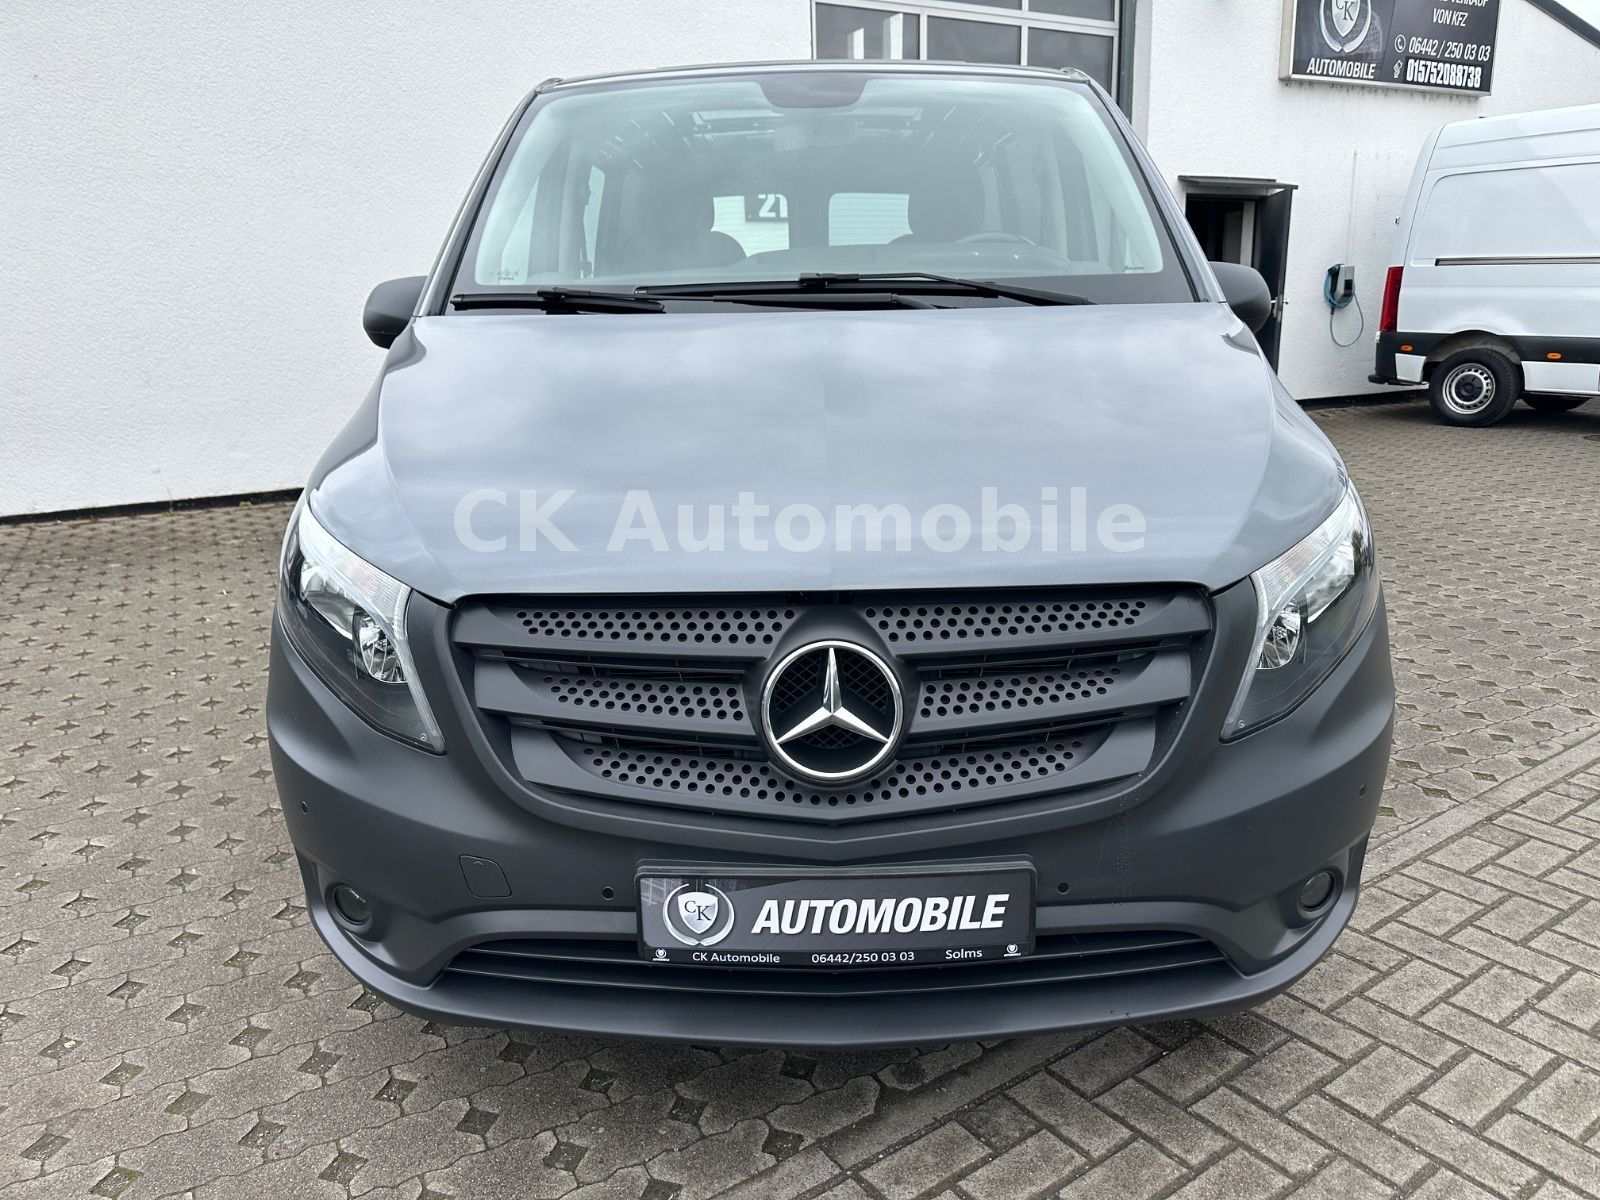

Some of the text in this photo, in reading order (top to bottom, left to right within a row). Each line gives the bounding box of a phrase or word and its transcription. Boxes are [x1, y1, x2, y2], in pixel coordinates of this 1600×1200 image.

[1432, 8, 1468, 27] VON KFZ
[1408, 36, 1438, 56] 06442
[1444, 41, 1464, 59] 250
[1464, 43, 1477, 60] 03
[1477, 45, 1491, 62] 03
[1306, 57, 1377, 80] AUTOMOBILE
[1406, 58, 1482, 88] 015752088738
[684, 900, 712, 921] CK
[751, 893, 1010, 935] AUTOMOBILE
[692, 948, 983, 965] CK Automobile 06442/250 03 03 Solms
